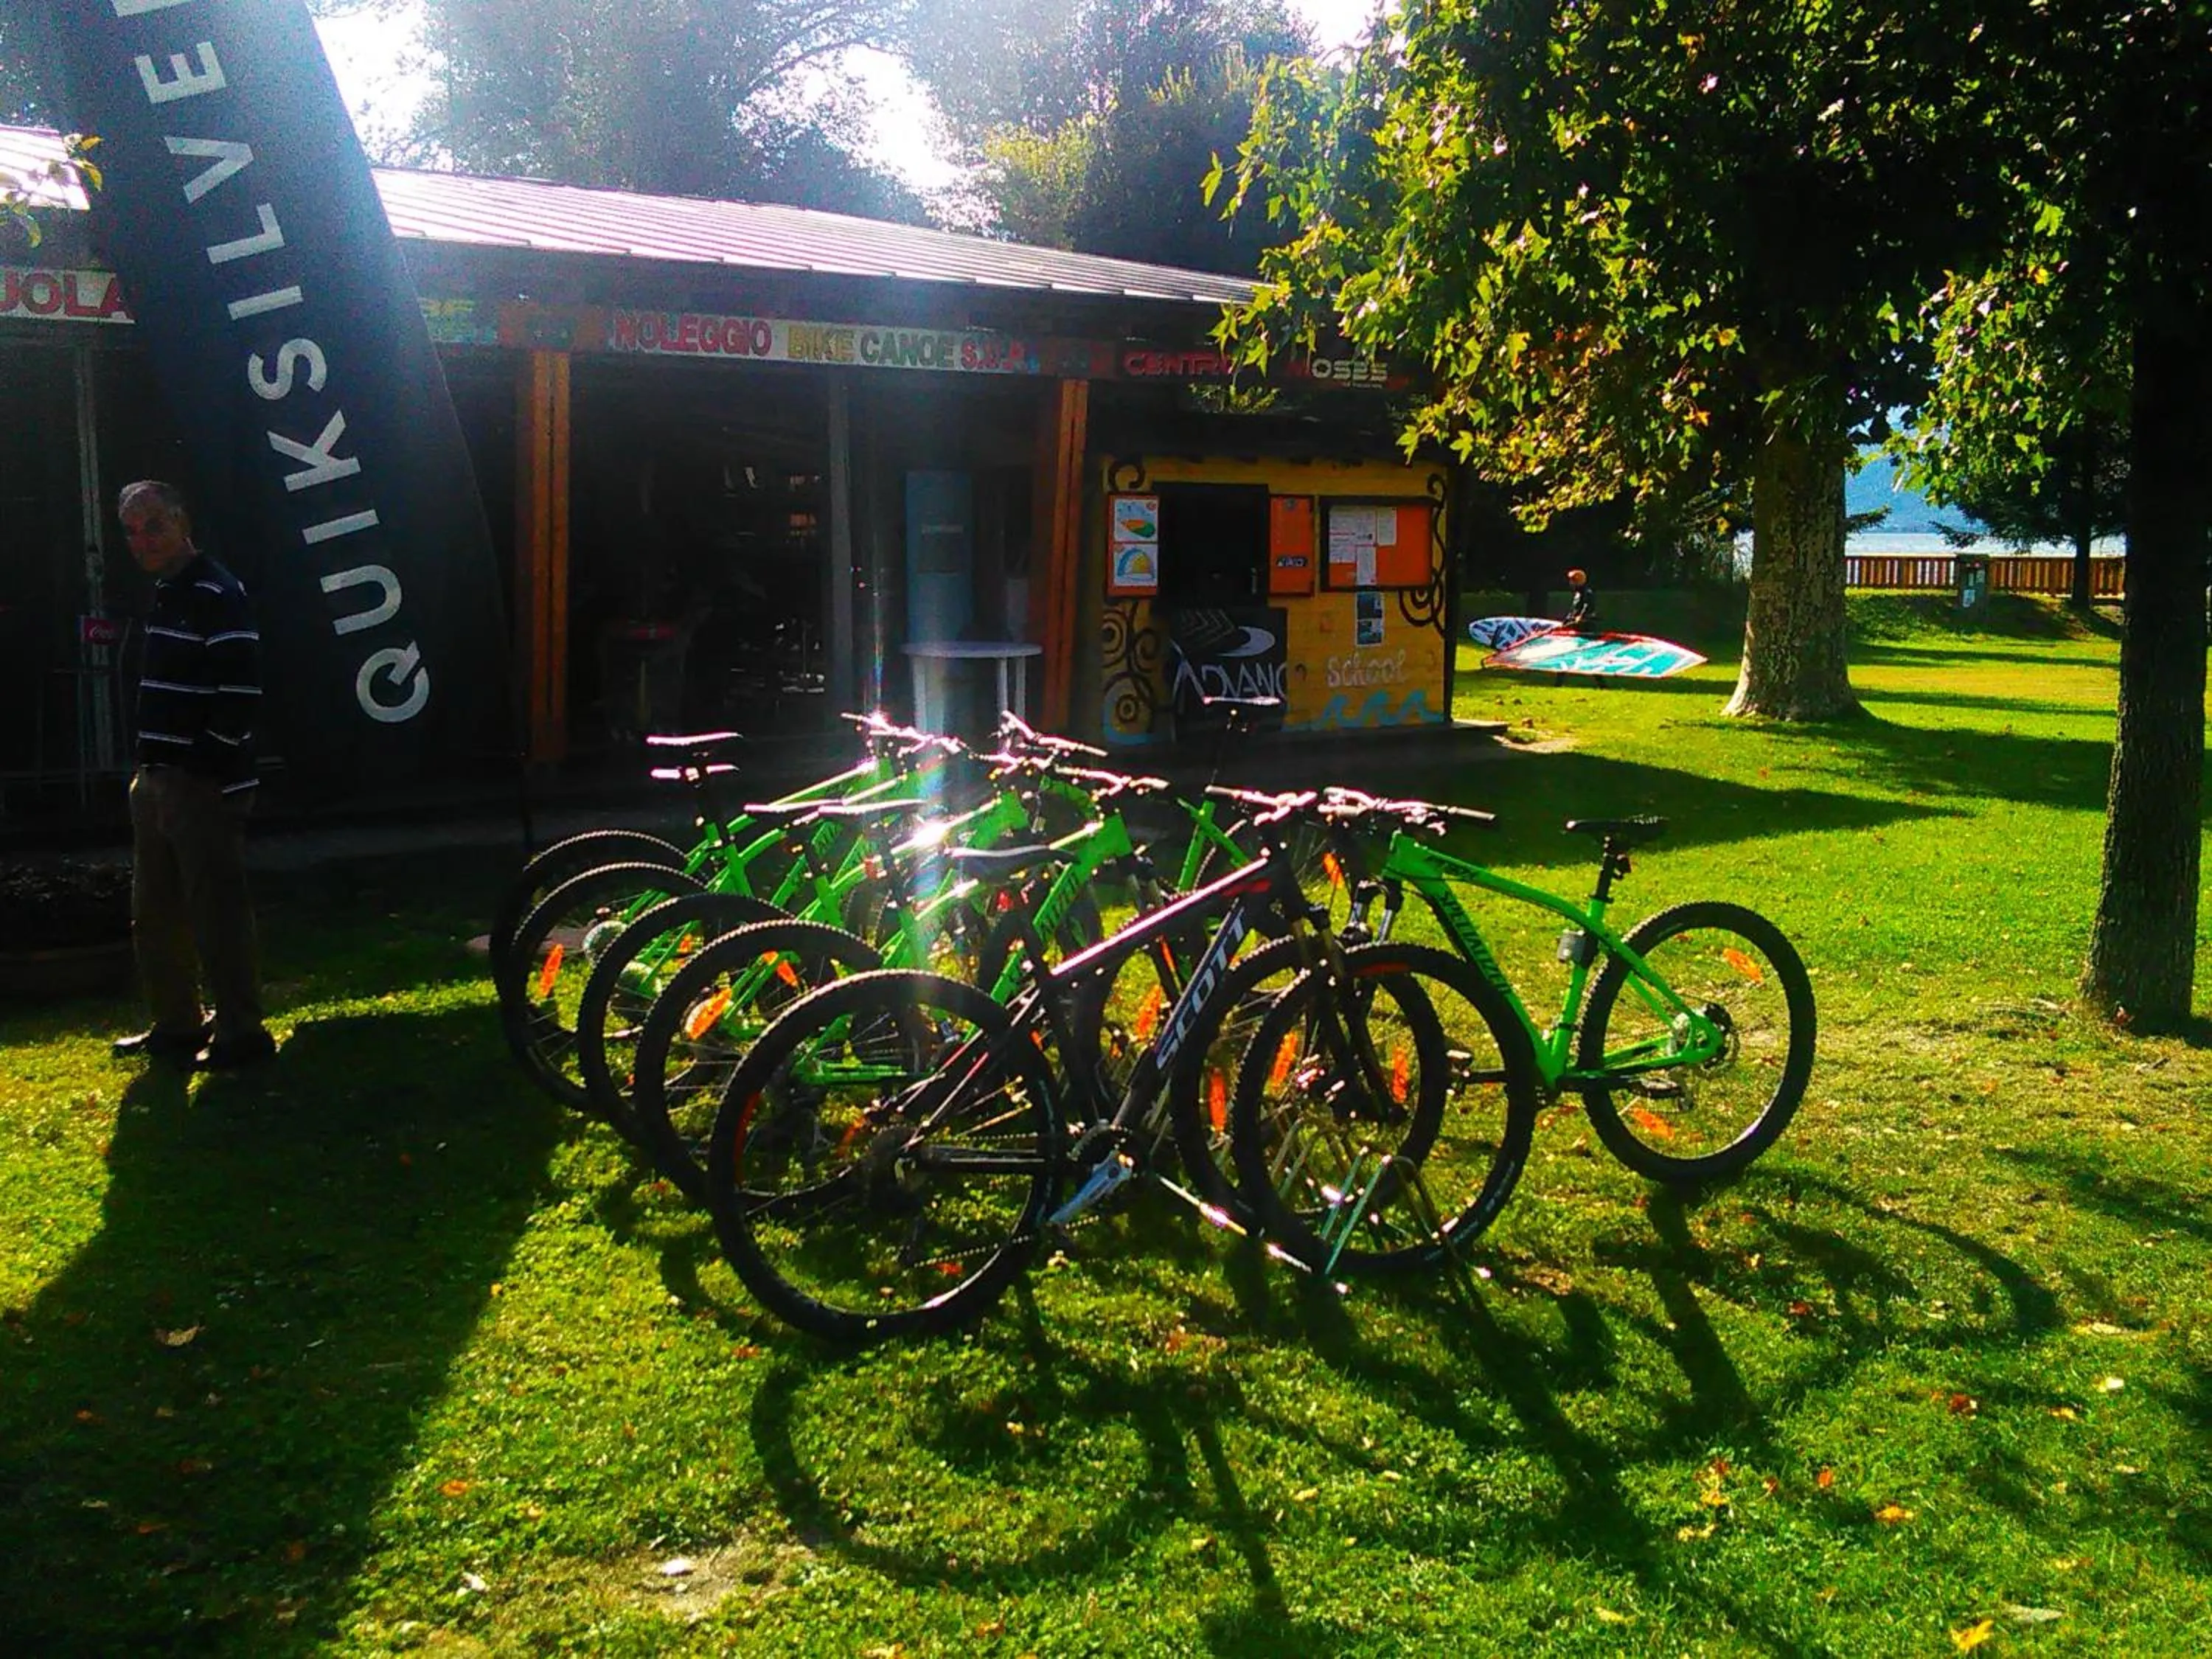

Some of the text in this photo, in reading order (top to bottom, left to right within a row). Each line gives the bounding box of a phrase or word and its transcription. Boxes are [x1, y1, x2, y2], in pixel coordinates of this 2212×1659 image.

[108, 0, 430, 723] QUIKSILVE
[614, 312, 773, 357] NOLEGGIO
[787, 324, 855, 362] BIKE
[860, 332, 957, 368] CANOE
[1156, 905, 1246, 1071] SCOTT
